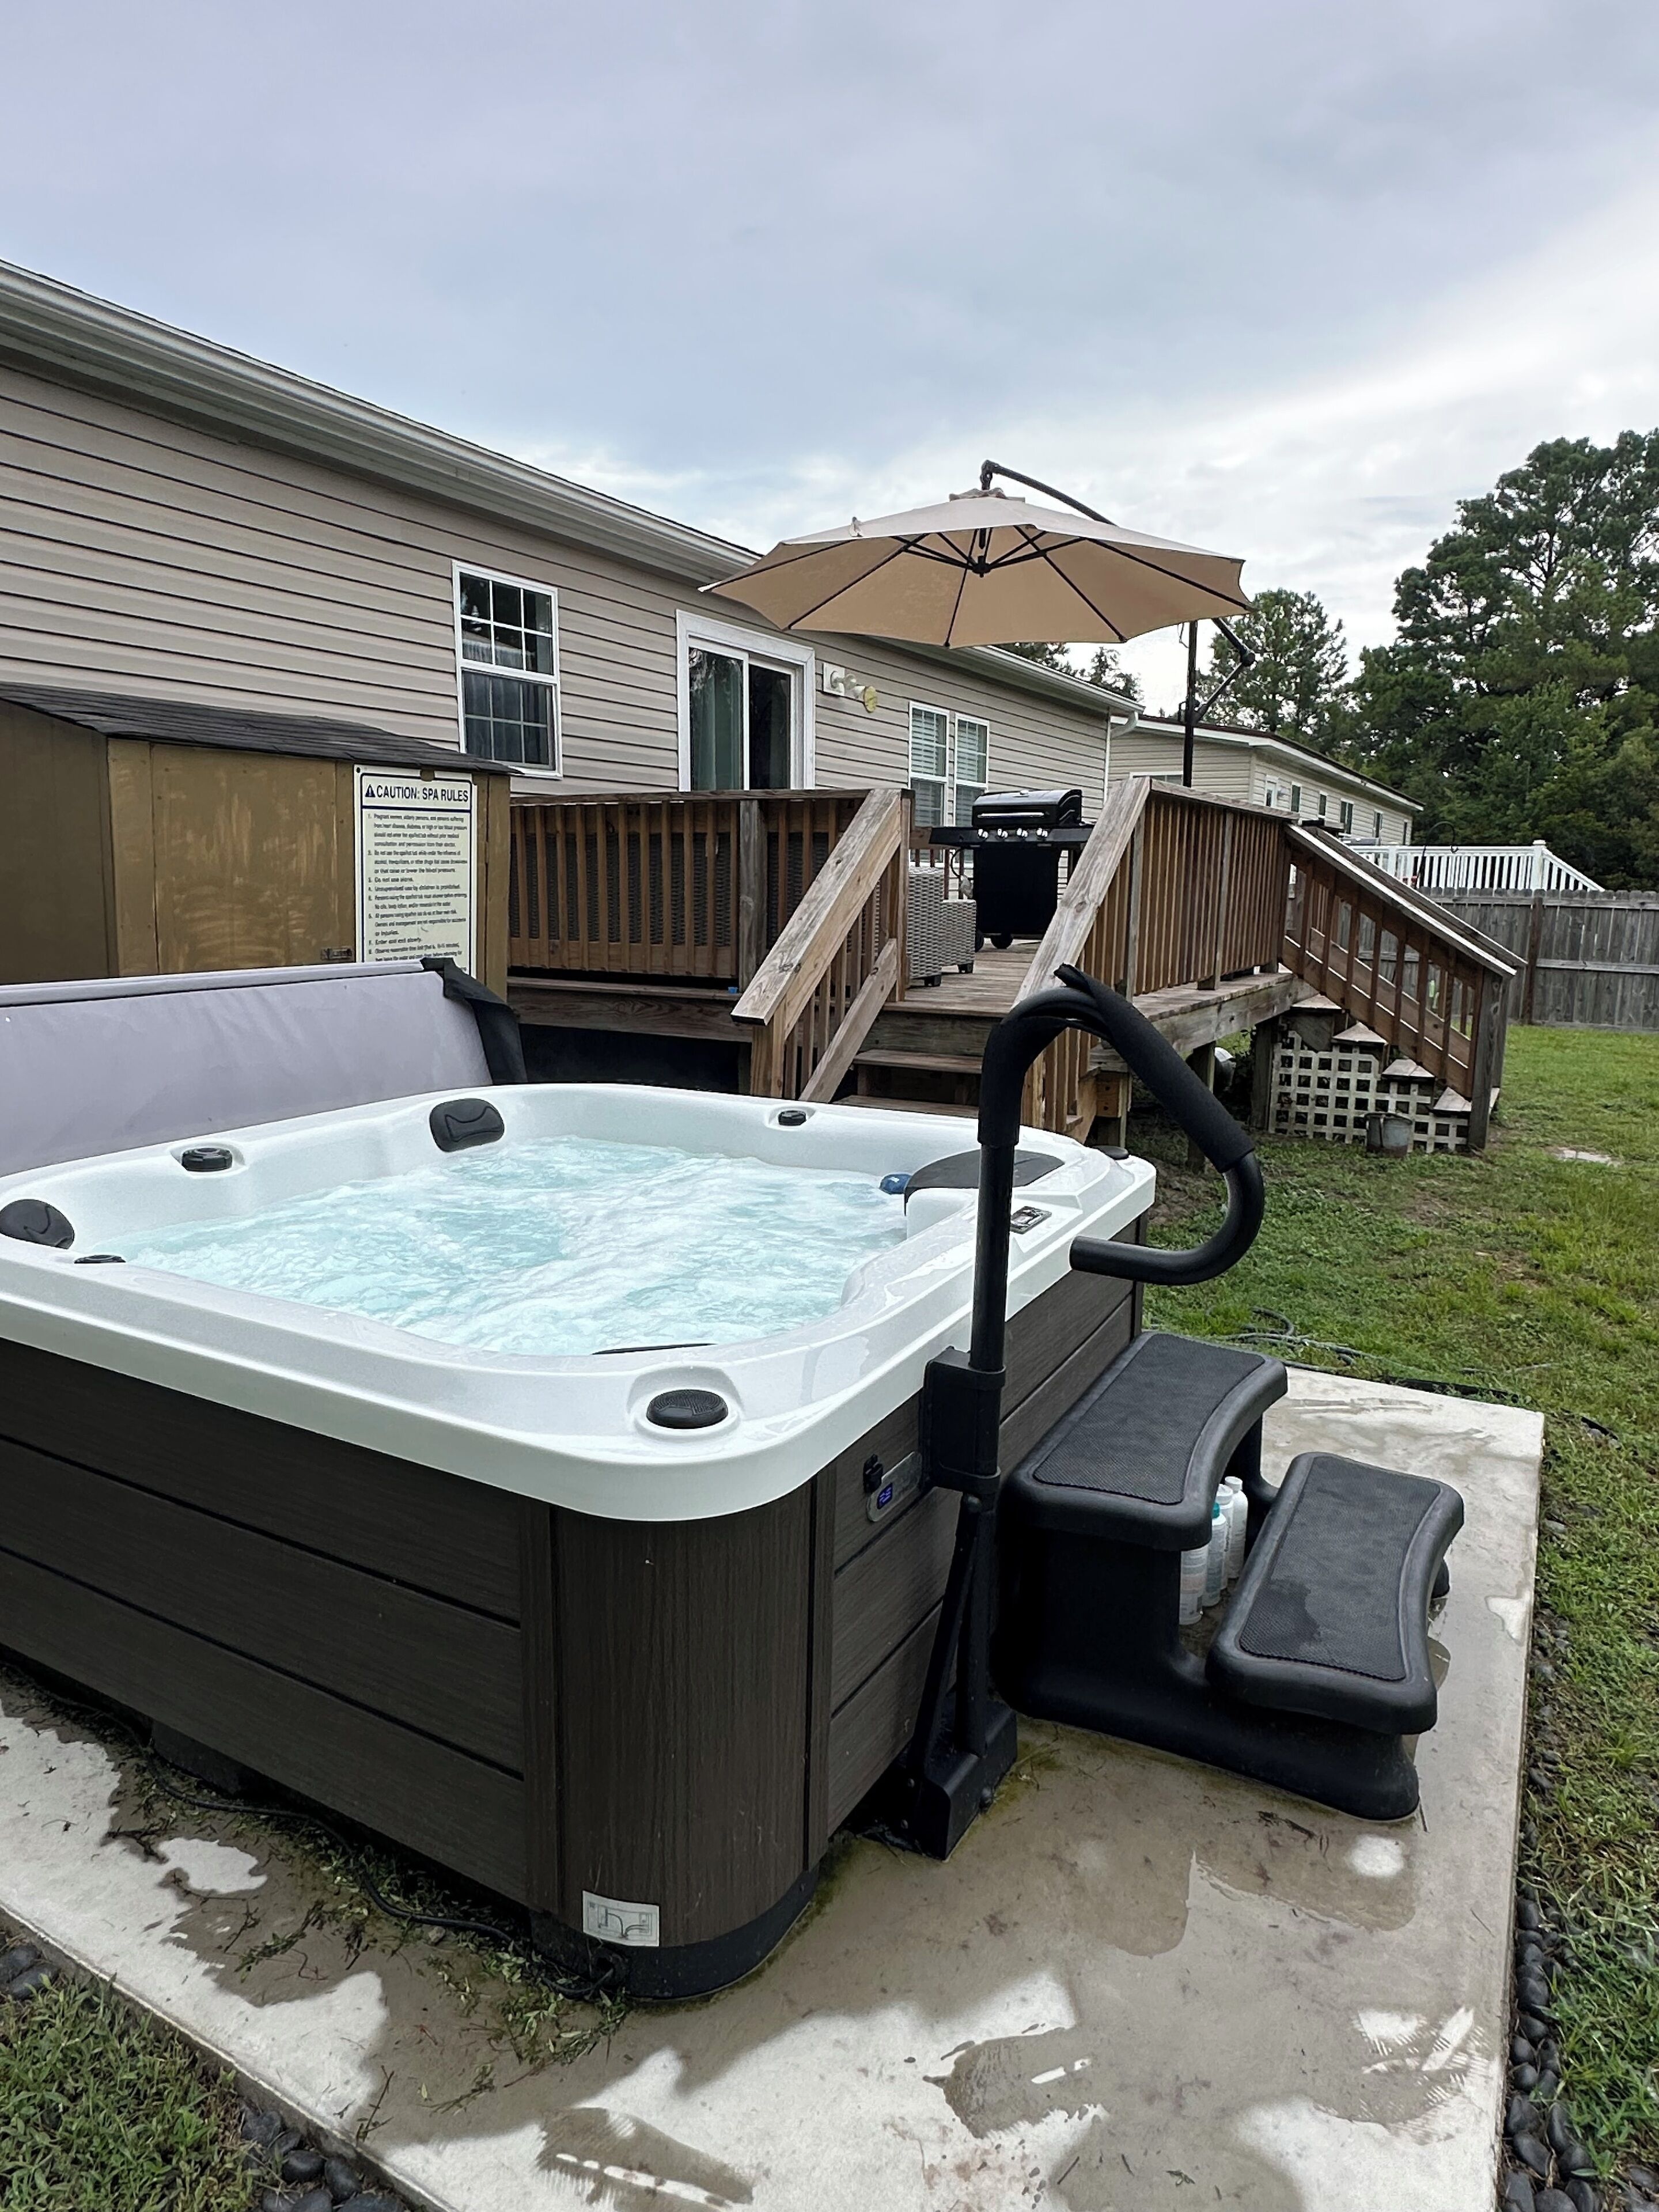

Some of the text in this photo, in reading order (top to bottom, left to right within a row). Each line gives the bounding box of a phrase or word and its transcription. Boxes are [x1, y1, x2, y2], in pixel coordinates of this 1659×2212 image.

[376, 785, 468, 802] CAUTION: SPA RULES
